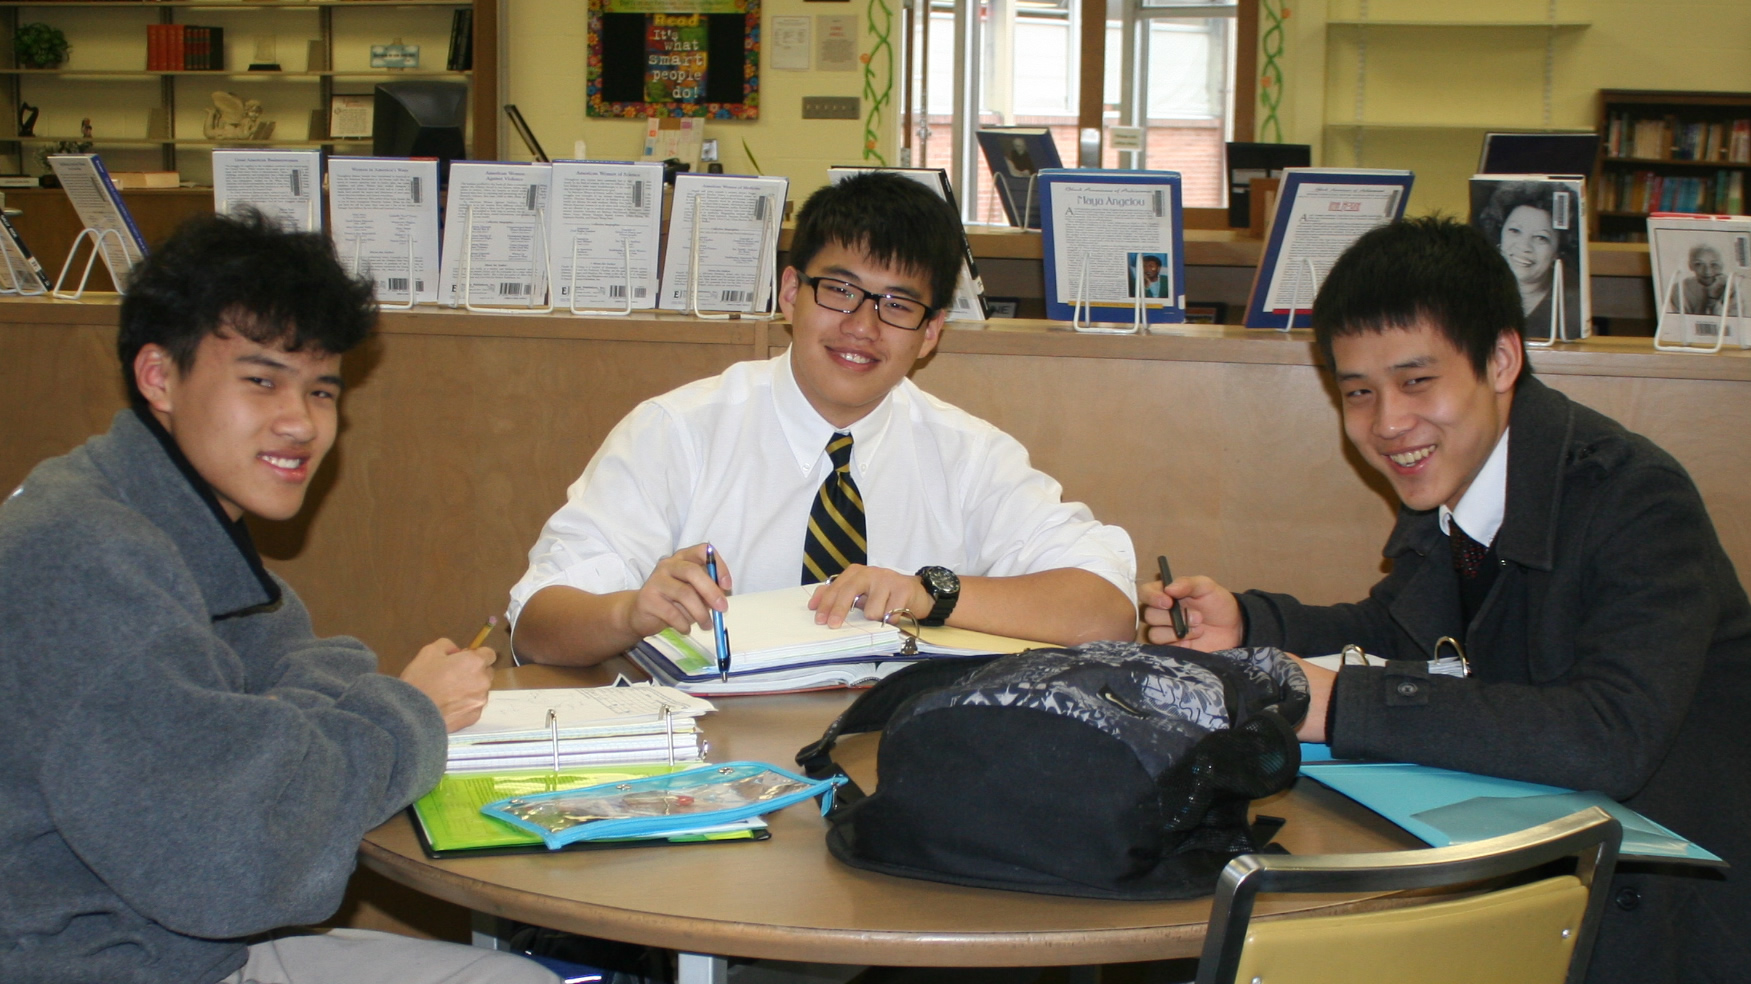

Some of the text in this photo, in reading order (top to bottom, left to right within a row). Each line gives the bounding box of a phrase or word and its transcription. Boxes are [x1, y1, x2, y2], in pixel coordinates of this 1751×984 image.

[653, 12, 700, 27] Read
[653, 29, 679, 41] It's
[663, 40, 699, 51] what
[648, 53, 703, 66] smart
[652, 68, 702, 83] people
[672, 85, 698, 99] do!
[1077, 195, 1146, 208] Maya Angelou
